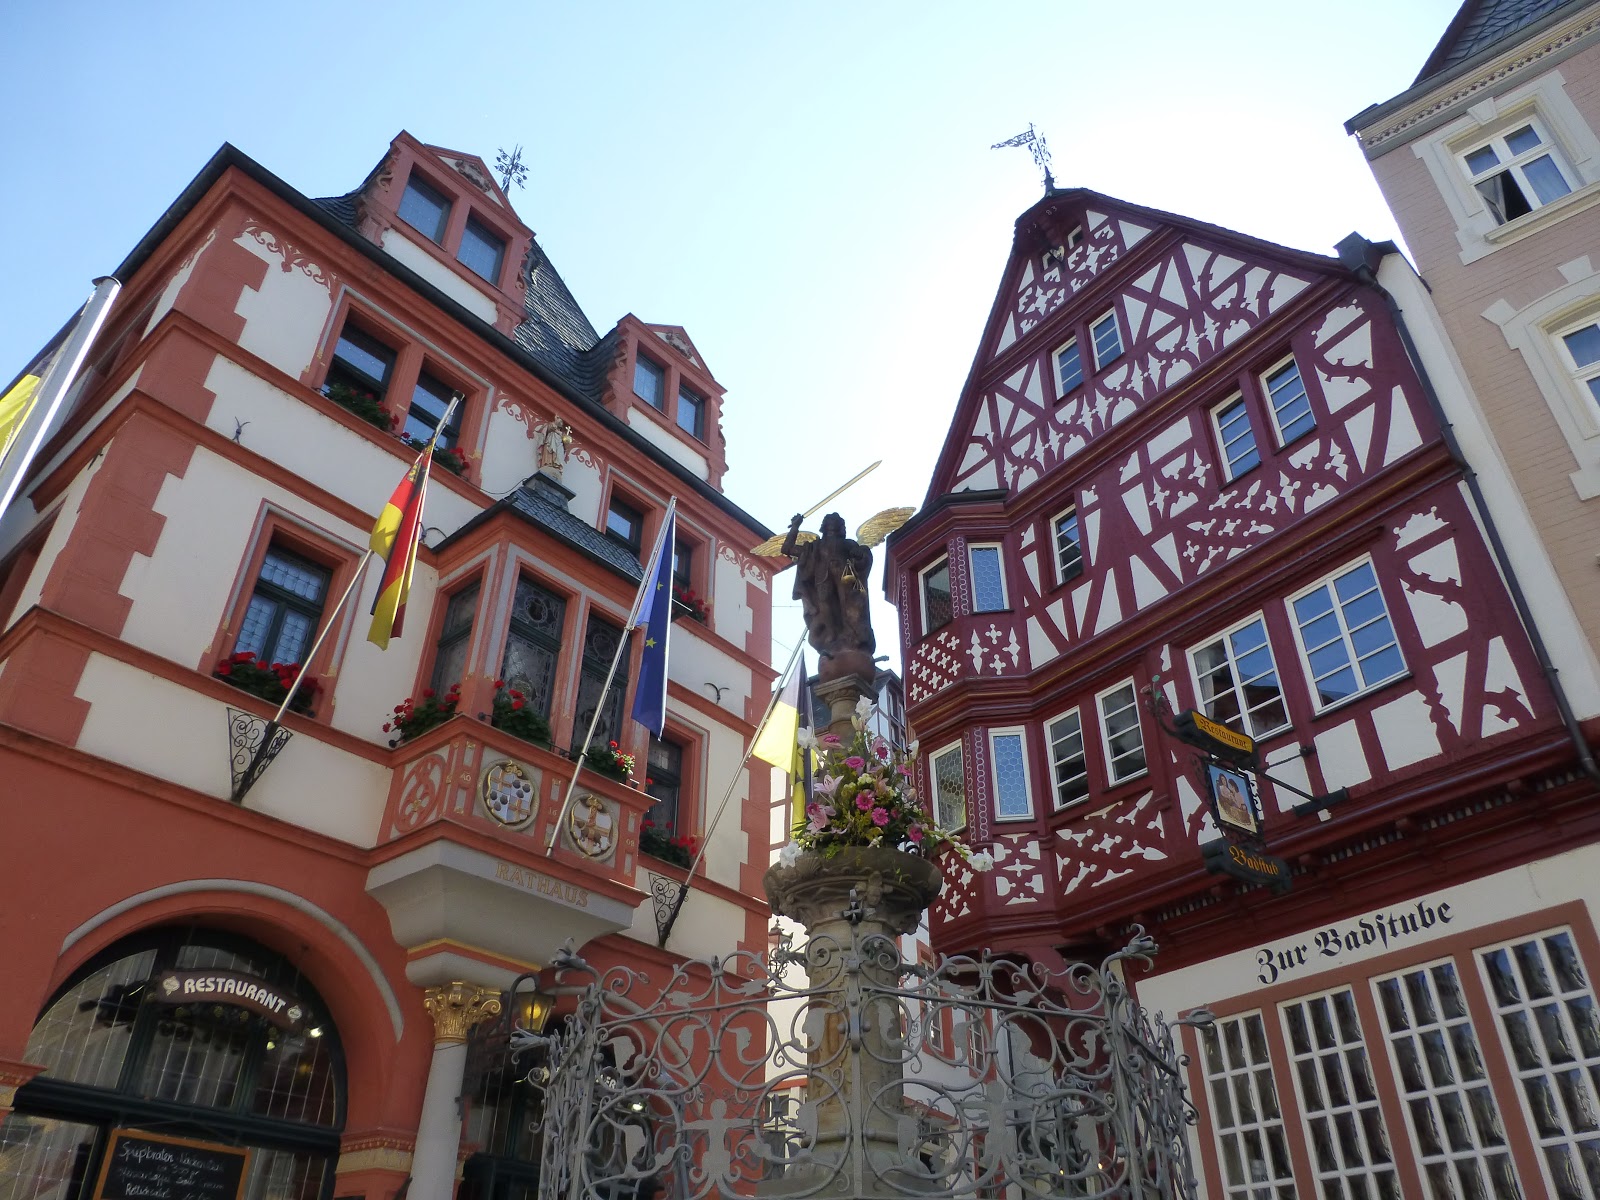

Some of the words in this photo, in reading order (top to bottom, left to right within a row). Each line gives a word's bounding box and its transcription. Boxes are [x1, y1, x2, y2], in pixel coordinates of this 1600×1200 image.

[1199, 717, 1248, 749] Restaurant
[495, 861, 589, 908] RATHAUS
[1255, 943, 1309, 985] Zur
[184, 977, 287, 1014] RESTAURANT
